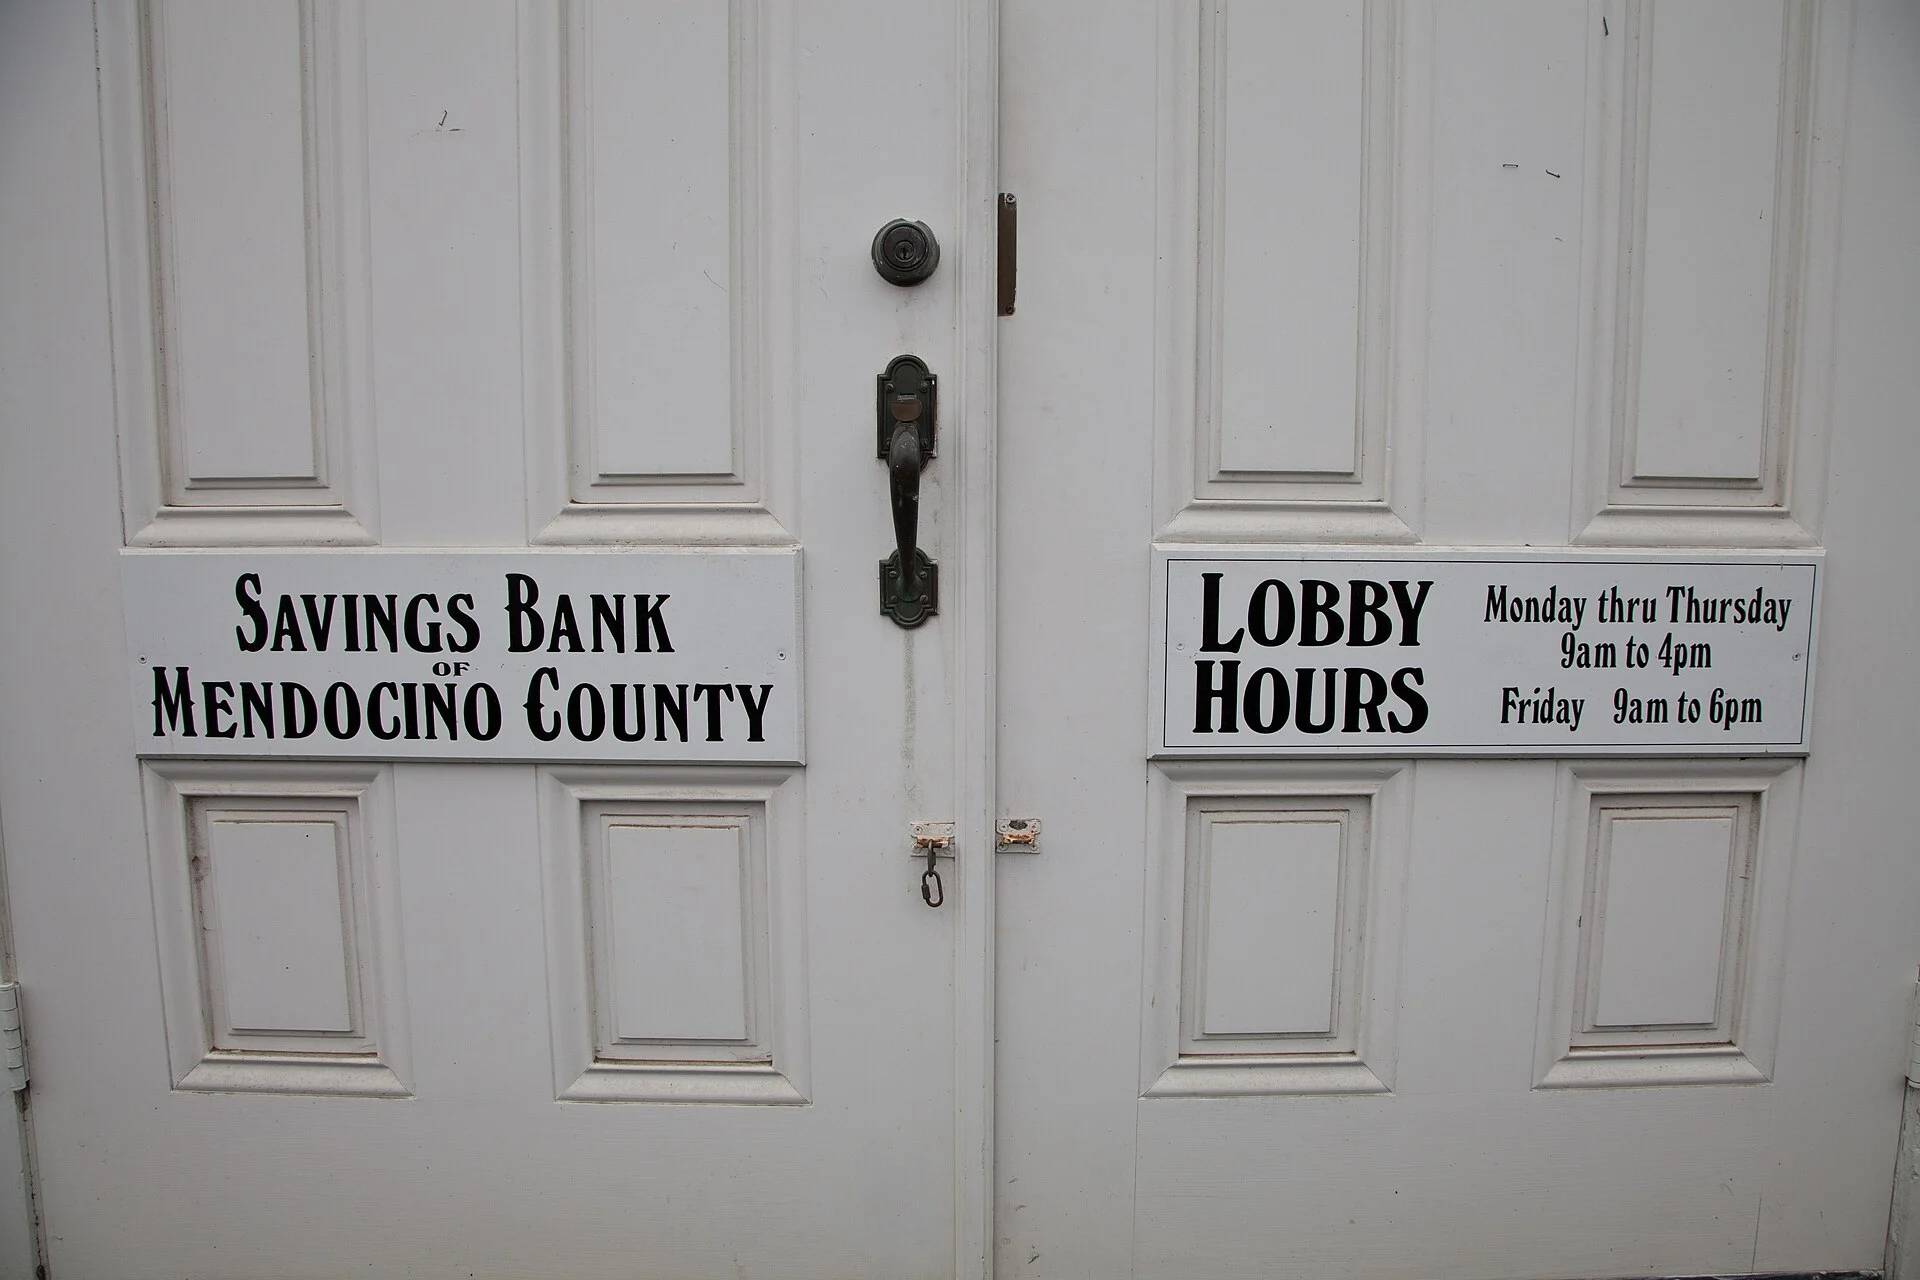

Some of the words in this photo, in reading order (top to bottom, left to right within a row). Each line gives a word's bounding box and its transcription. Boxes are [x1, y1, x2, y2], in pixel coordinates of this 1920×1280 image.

[235, 572, 481, 654] SAVINGS
[504, 572, 676, 654] BANK
[1199, 572, 1435, 654] LOBBY
[1484, 584, 1588, 632] Monday
[1597, 589, 1657, 624] thru
[1665, 585, 1793, 632] Thursday
[432, 661, 471, 677] OF
[1560, 631, 1617, 669] 9am
[1625, 635, 1650, 669] to
[1657, 632, 1712, 677] 4pm
[151, 666, 502, 742] MENDOCINO
[522, 666, 774, 743] COUNTY
[1192, 659, 1429, 734] HOURS
[1500, 686, 1586, 732] Friday
[1613, 687, 1669, 725] 9am
[1677, 691, 1701, 724] to
[1709, 687, 1763, 731] 6pm
